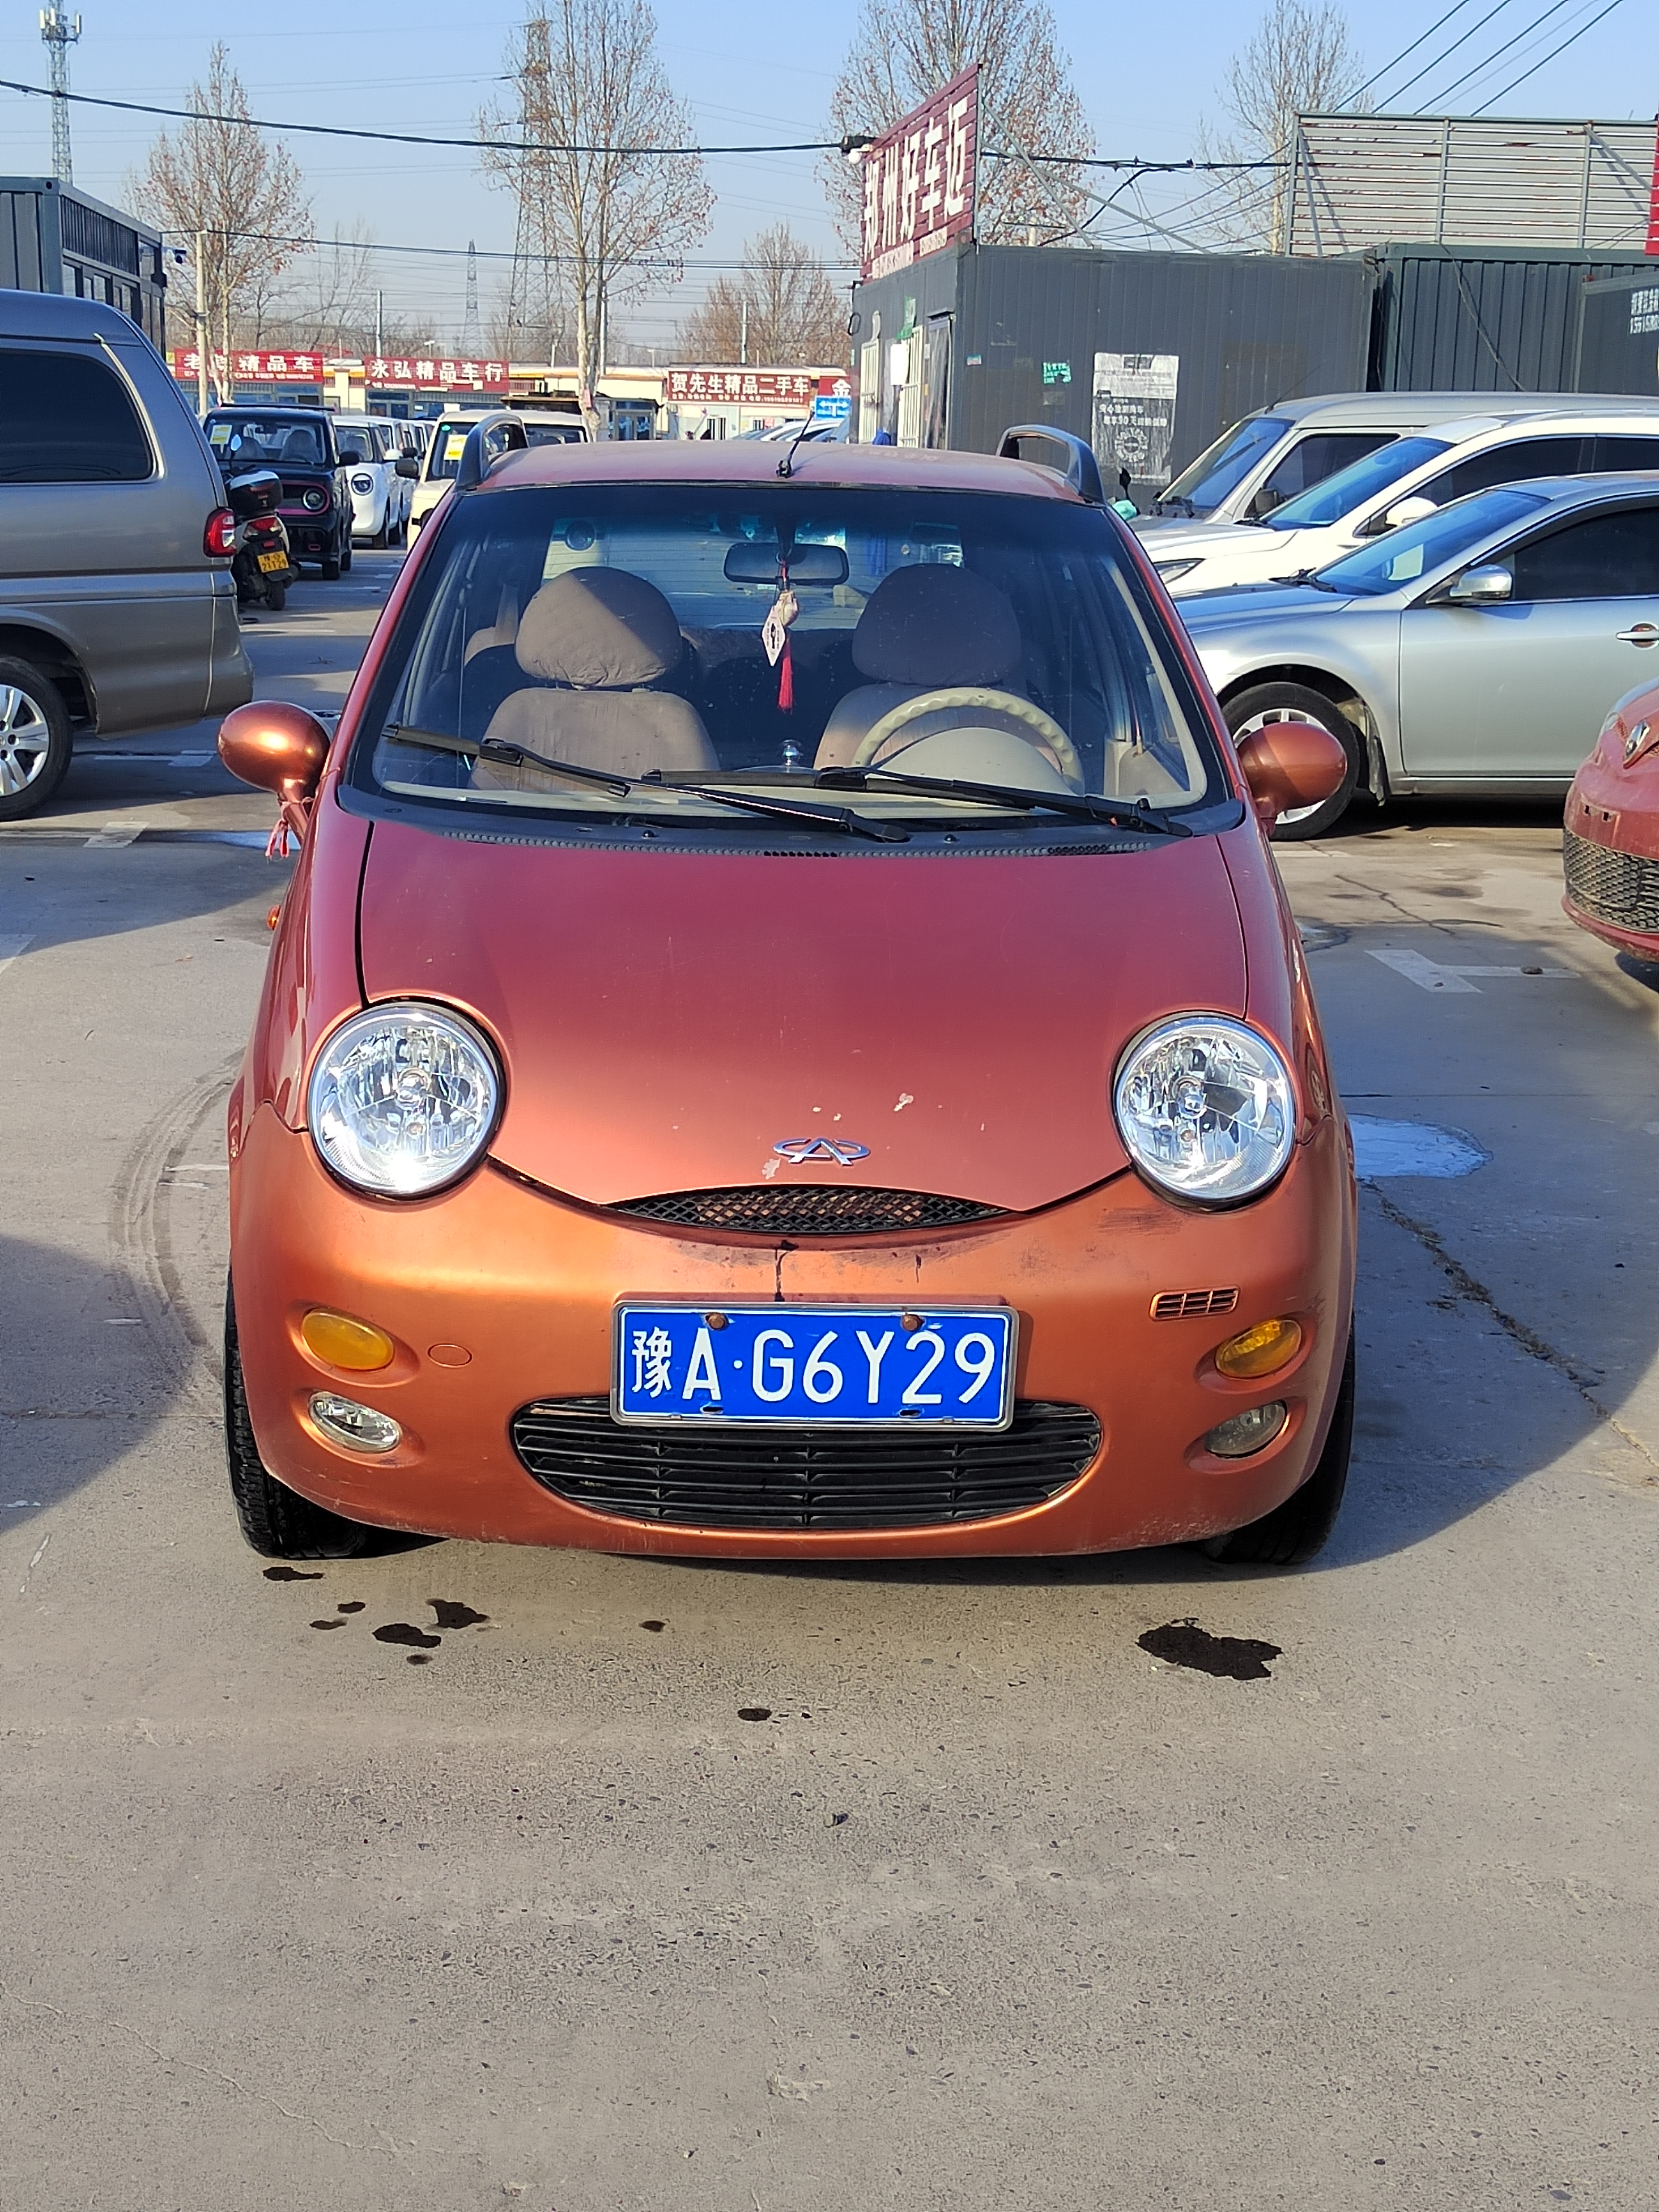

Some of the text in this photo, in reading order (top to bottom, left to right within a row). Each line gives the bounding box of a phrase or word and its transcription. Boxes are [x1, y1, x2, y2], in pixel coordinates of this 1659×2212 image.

[371, 359, 503, 382] 永弘精品车行
[671, 372, 809, 397] 贺先生精品二手车
[631, 1326, 995, 1404] 豫A·G6Y29
